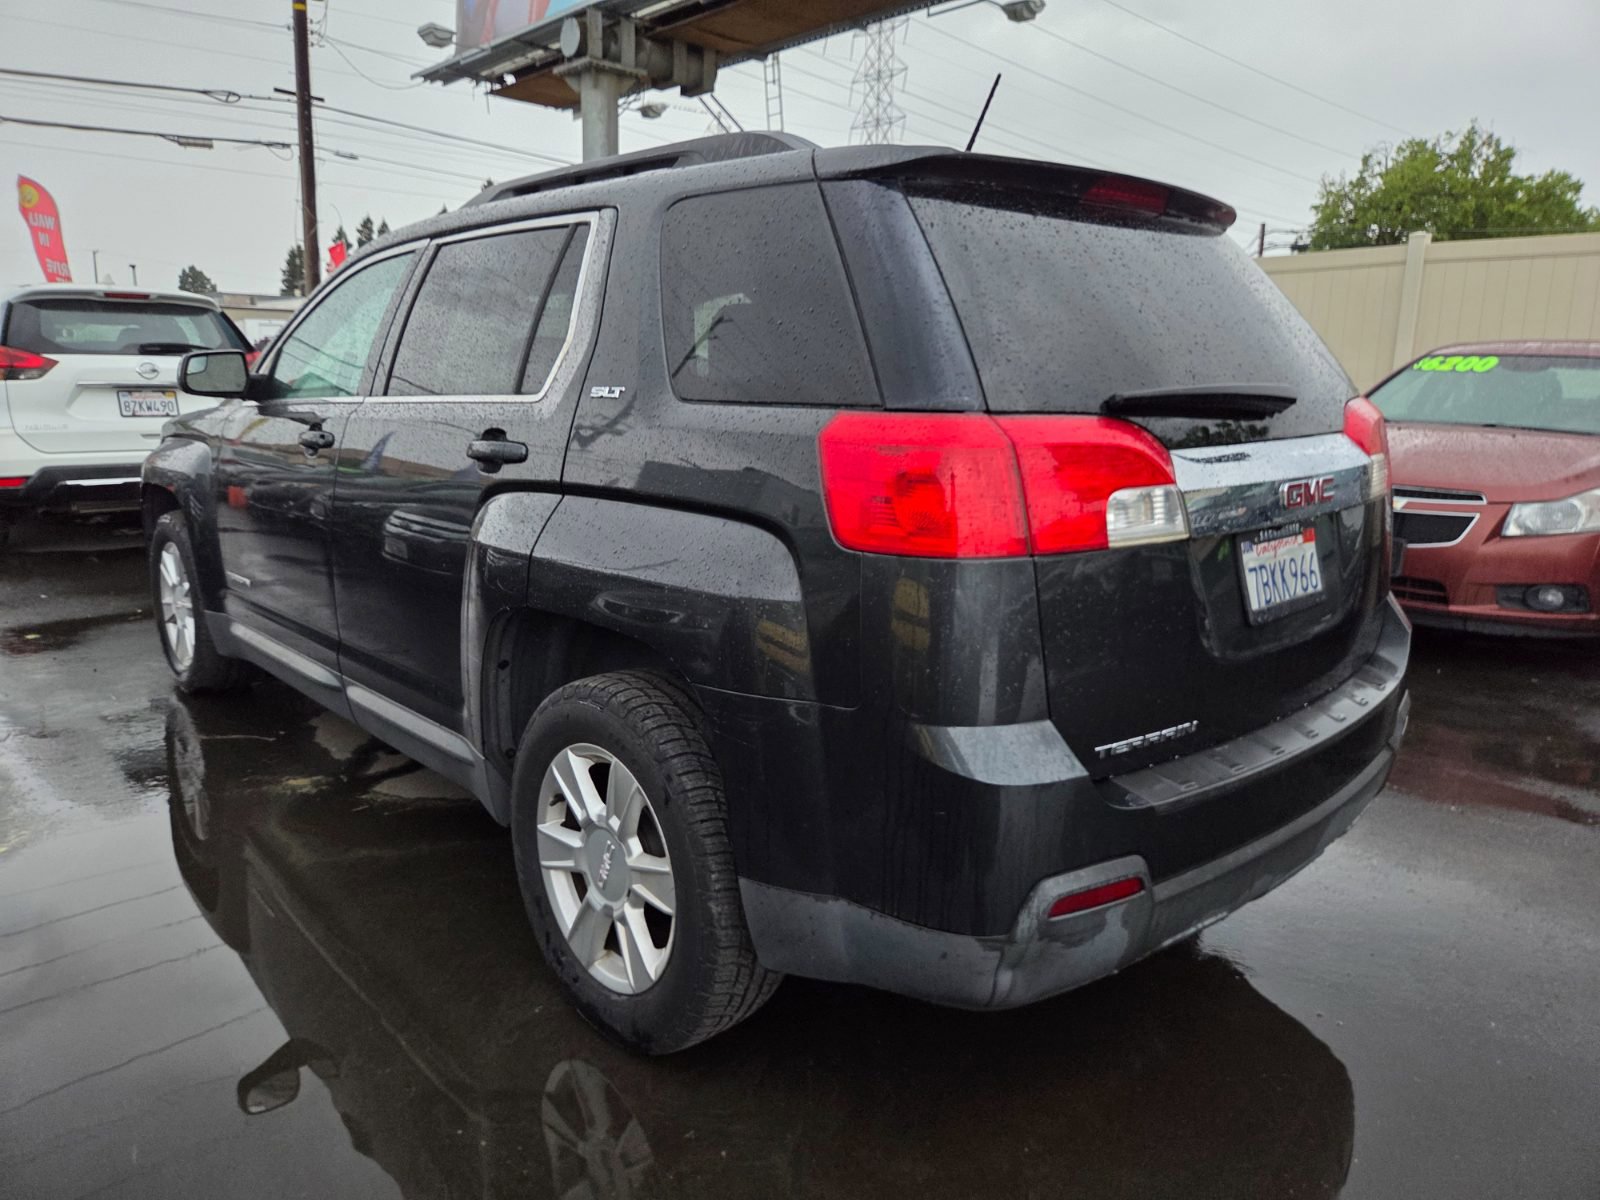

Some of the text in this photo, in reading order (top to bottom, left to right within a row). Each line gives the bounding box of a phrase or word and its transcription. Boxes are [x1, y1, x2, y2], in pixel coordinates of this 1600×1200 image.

[590, 386, 625, 398] SLT
[1280, 475, 1335, 509] GMC
[1248, 552, 1319, 607] 7BKK966
[1094, 720, 1199, 758] TERRAIN
